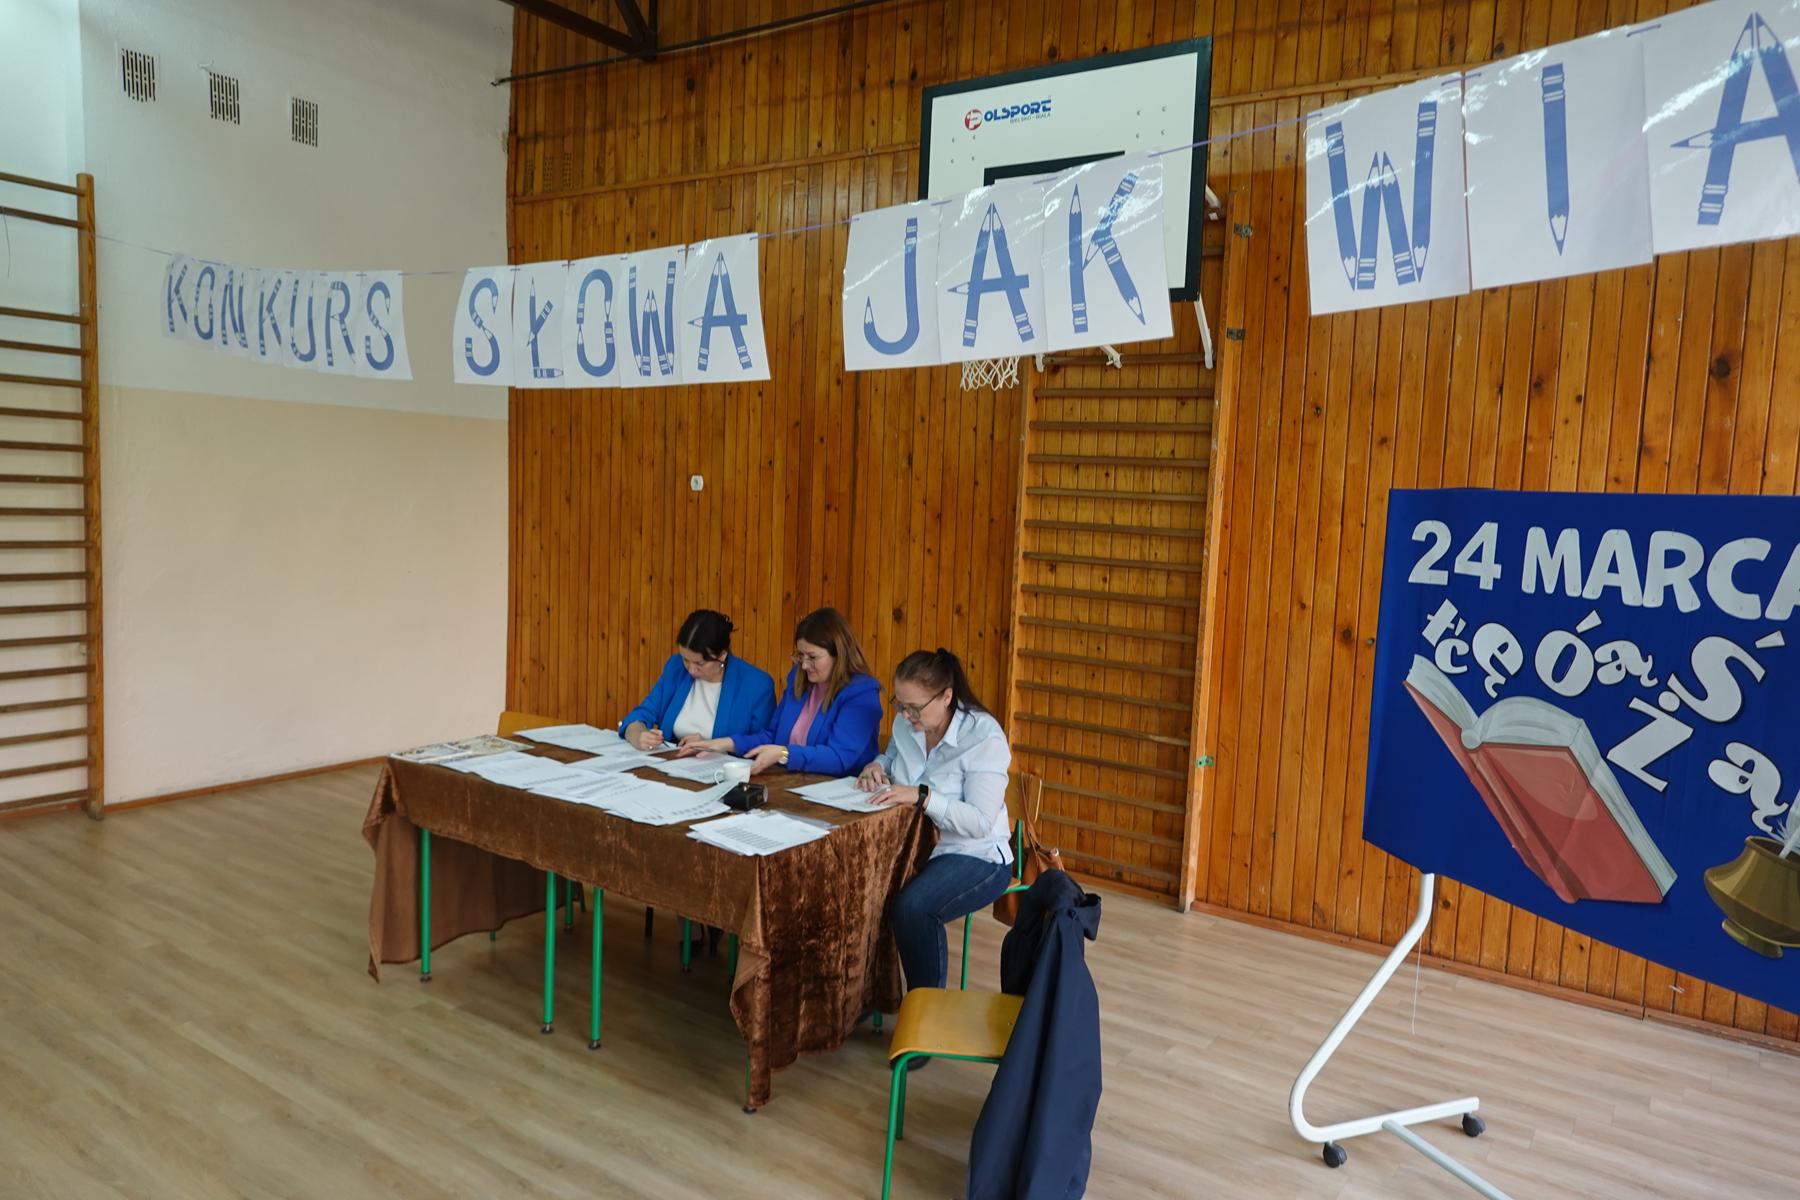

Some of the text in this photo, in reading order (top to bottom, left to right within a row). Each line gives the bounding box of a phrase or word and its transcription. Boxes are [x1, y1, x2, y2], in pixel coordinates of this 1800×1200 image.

[167, 263, 395, 371] KONKURS
[464, 251, 753, 379] SŁOWA
[863, 170, 1146, 355] JAK
[1408, 519, 1502, 591] 24
